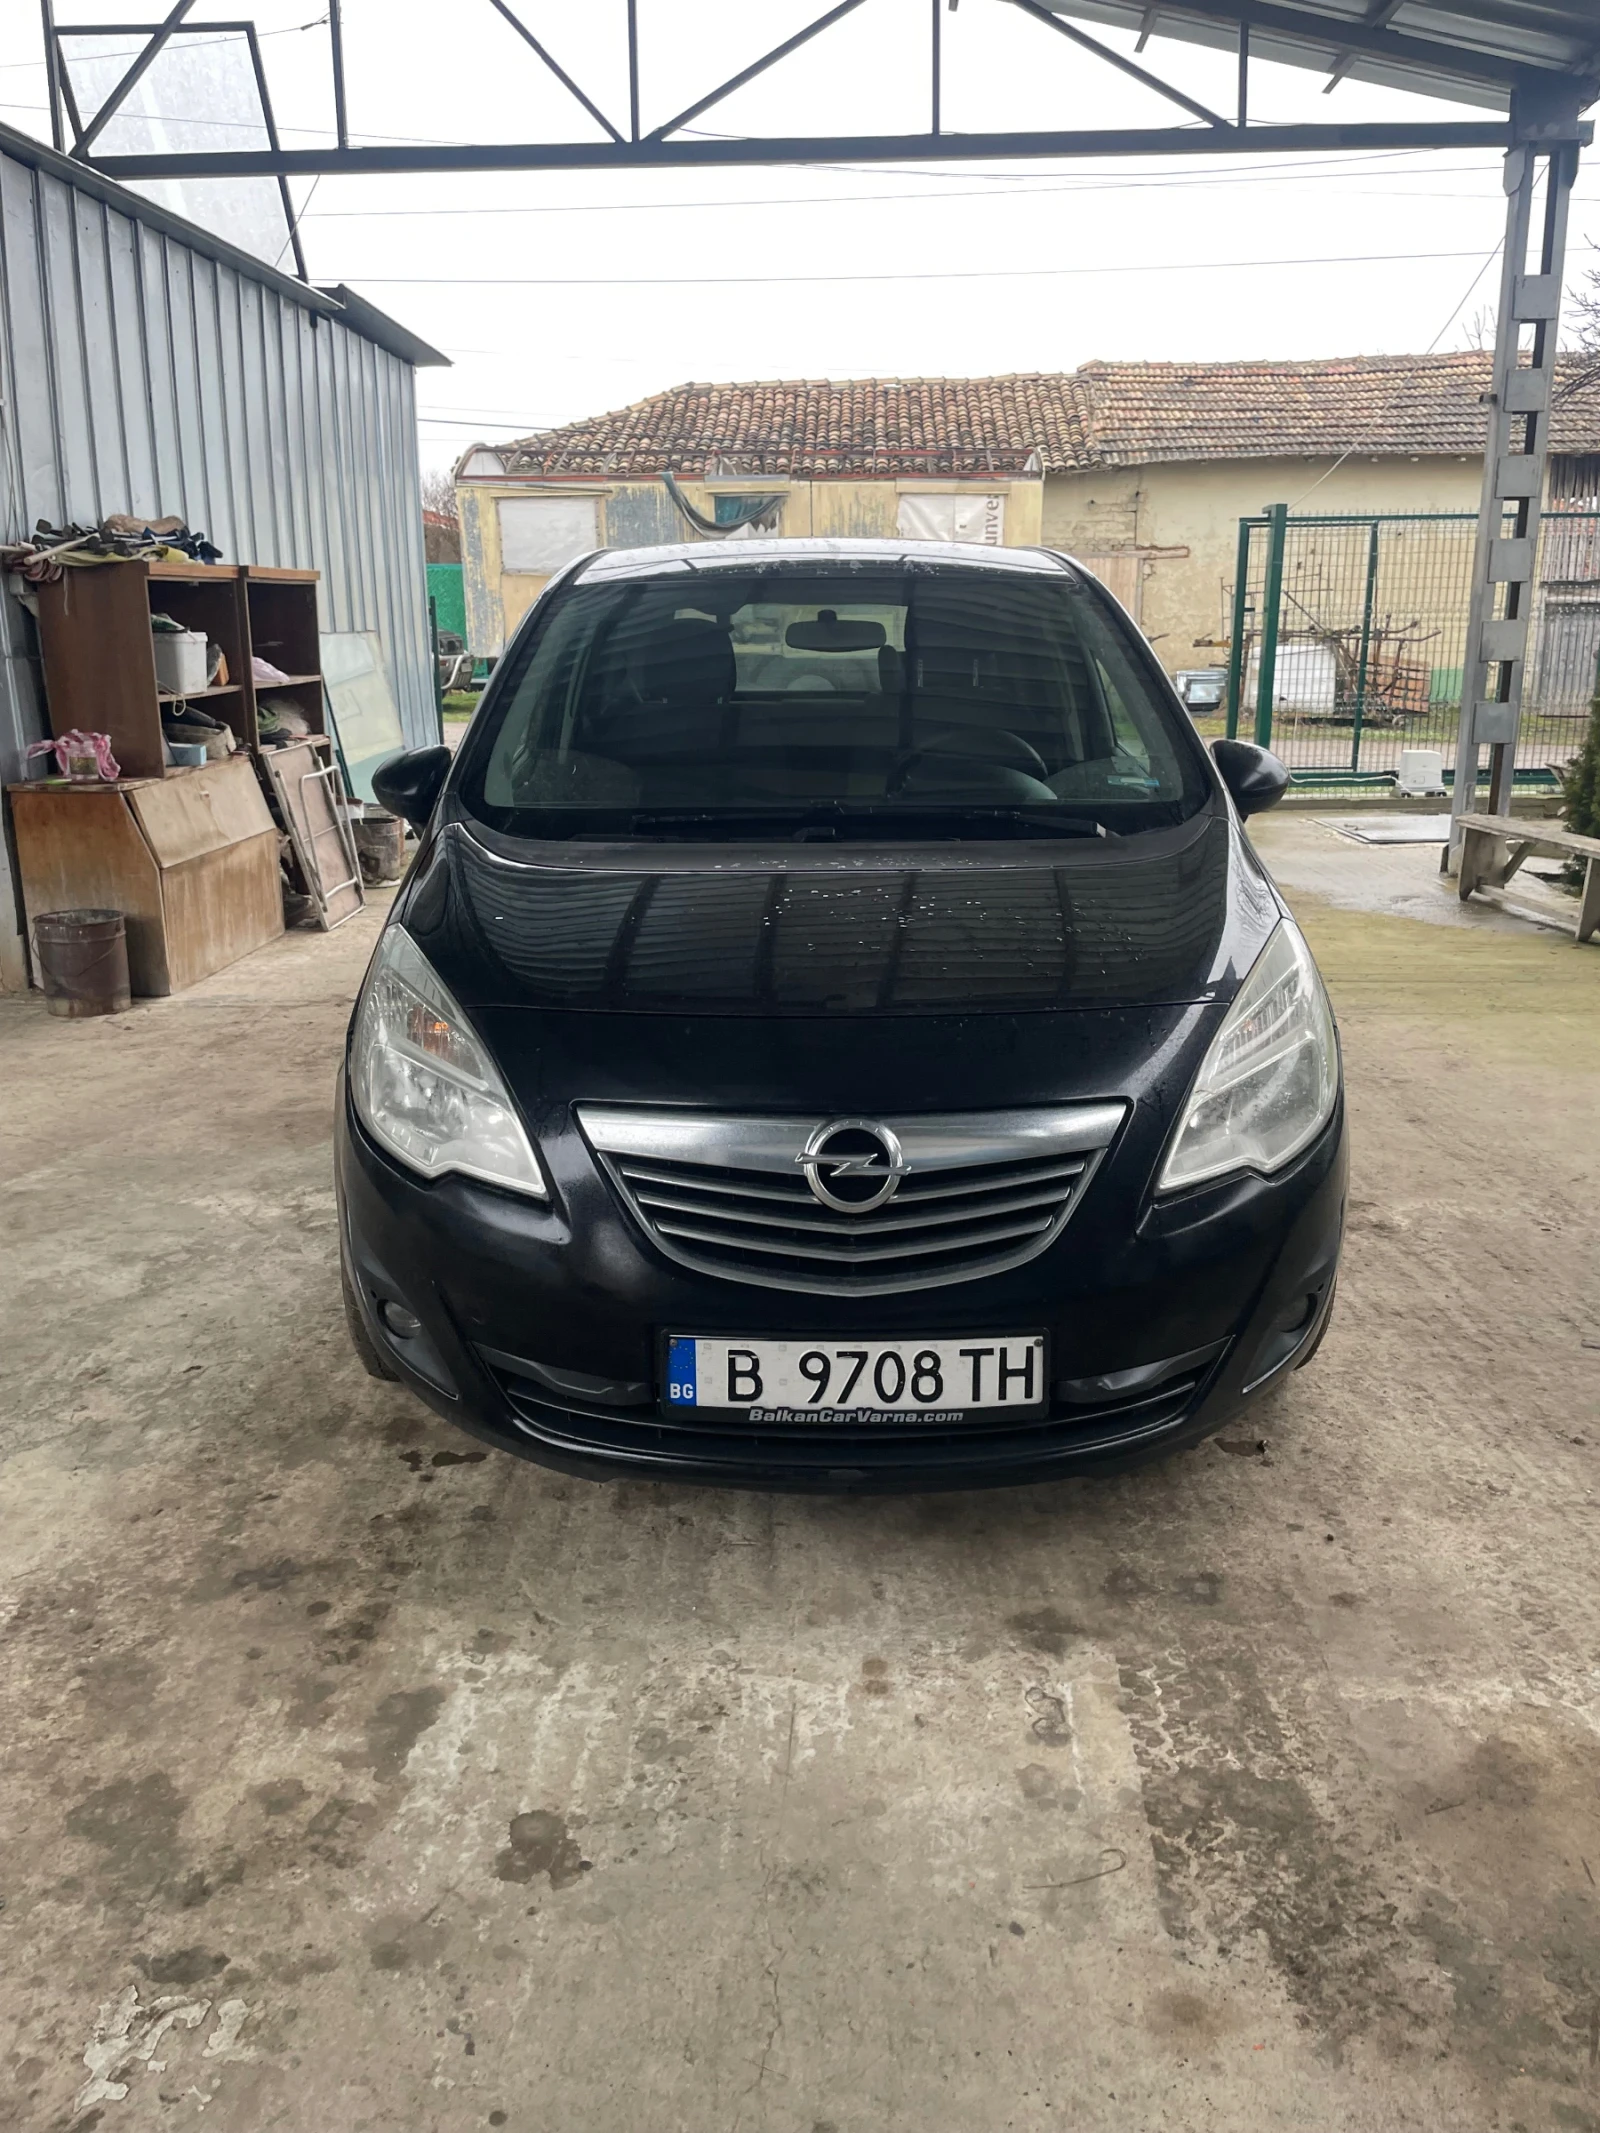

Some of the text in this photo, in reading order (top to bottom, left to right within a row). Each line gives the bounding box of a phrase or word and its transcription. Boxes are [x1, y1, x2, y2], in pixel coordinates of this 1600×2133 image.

[728, 1346, 1034, 1404] B 9708 TH
[670, 1383, 694, 1399] BG
[749, 1407, 963, 1423] BalkanCarVarna.com
